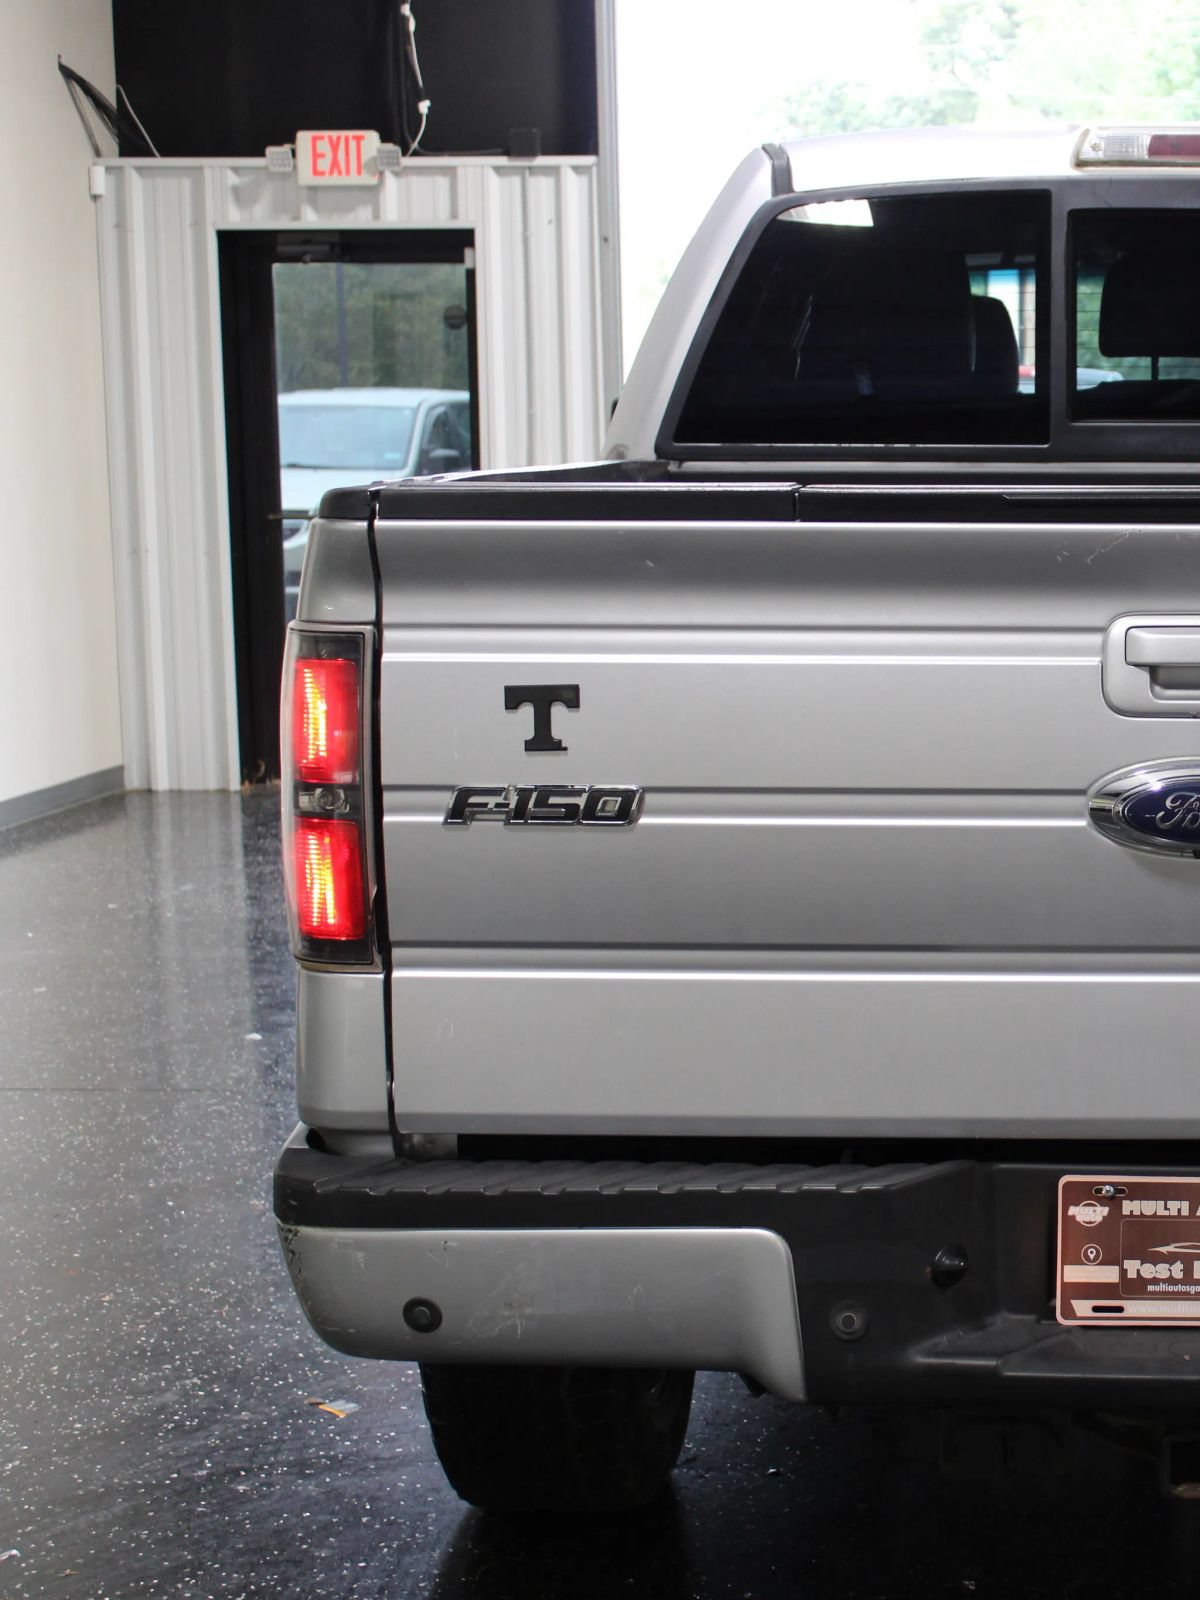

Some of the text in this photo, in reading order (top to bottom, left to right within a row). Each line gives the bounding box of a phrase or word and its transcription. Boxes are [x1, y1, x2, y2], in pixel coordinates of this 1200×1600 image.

[311, 135, 365, 177] EXIT
[504, 684, 580, 752] T
[443, 785, 645, 826] F-150
[1122, 1200, 1190, 1216] MULTI
[1123, 1260, 1184, 1279] Test
